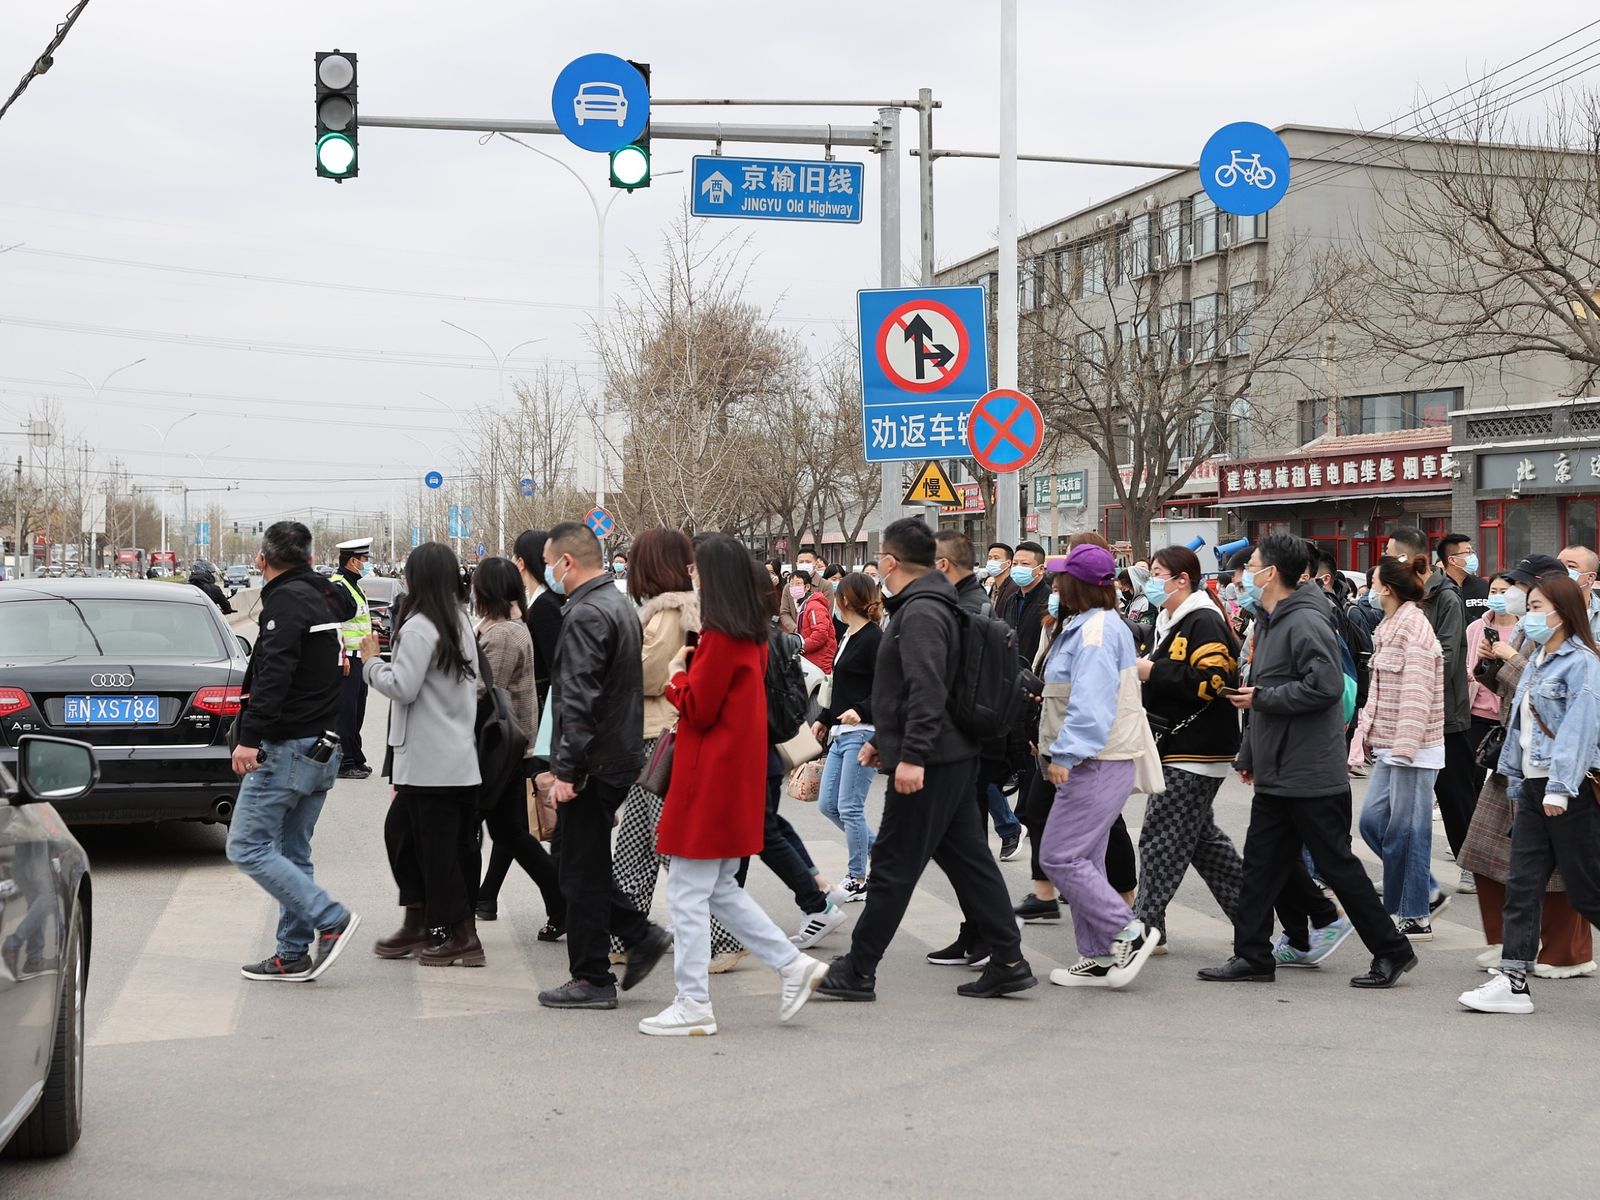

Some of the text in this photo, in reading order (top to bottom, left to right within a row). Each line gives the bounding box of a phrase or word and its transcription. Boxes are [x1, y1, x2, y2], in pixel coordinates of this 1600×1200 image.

[711, 179, 723, 192] 西
[741, 165, 854, 195] 京榆旧线
[712, 193, 721, 203] W
[741, 197, 853, 218] JINGYU Old Highway
[922, 477, 941, 498] 慢
[67, 698, 157, 720] 京N·XS786
